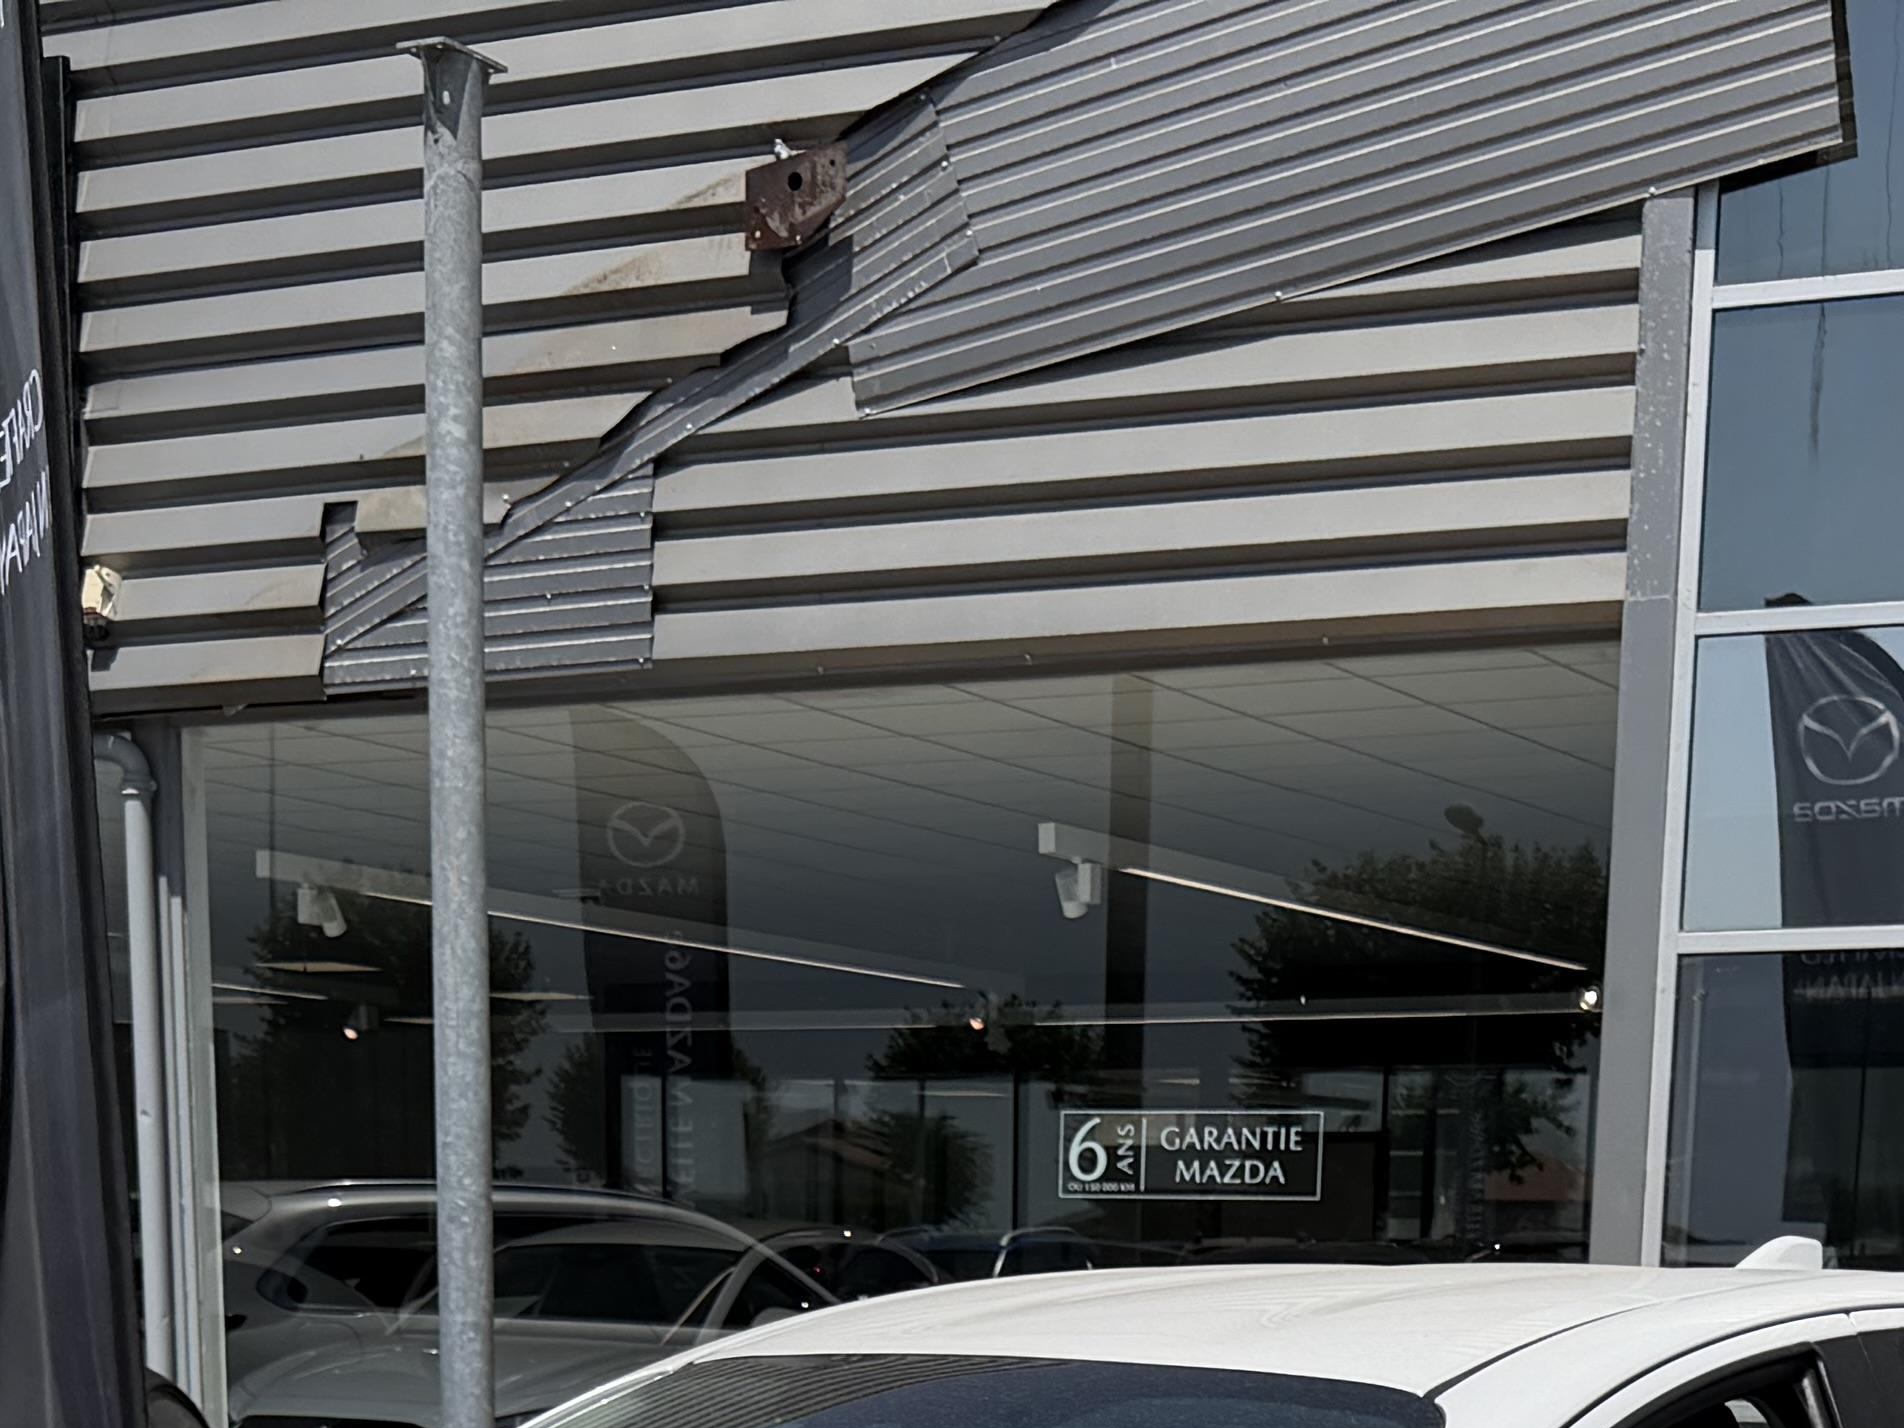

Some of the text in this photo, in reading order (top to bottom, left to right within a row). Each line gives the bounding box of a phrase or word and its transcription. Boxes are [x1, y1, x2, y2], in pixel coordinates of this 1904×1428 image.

[1068, 1117, 1135, 1181] 6 ANS
[1160, 1127, 1303, 1152] GARANTIE
[1174, 1159, 1286, 1185] MAZDA
